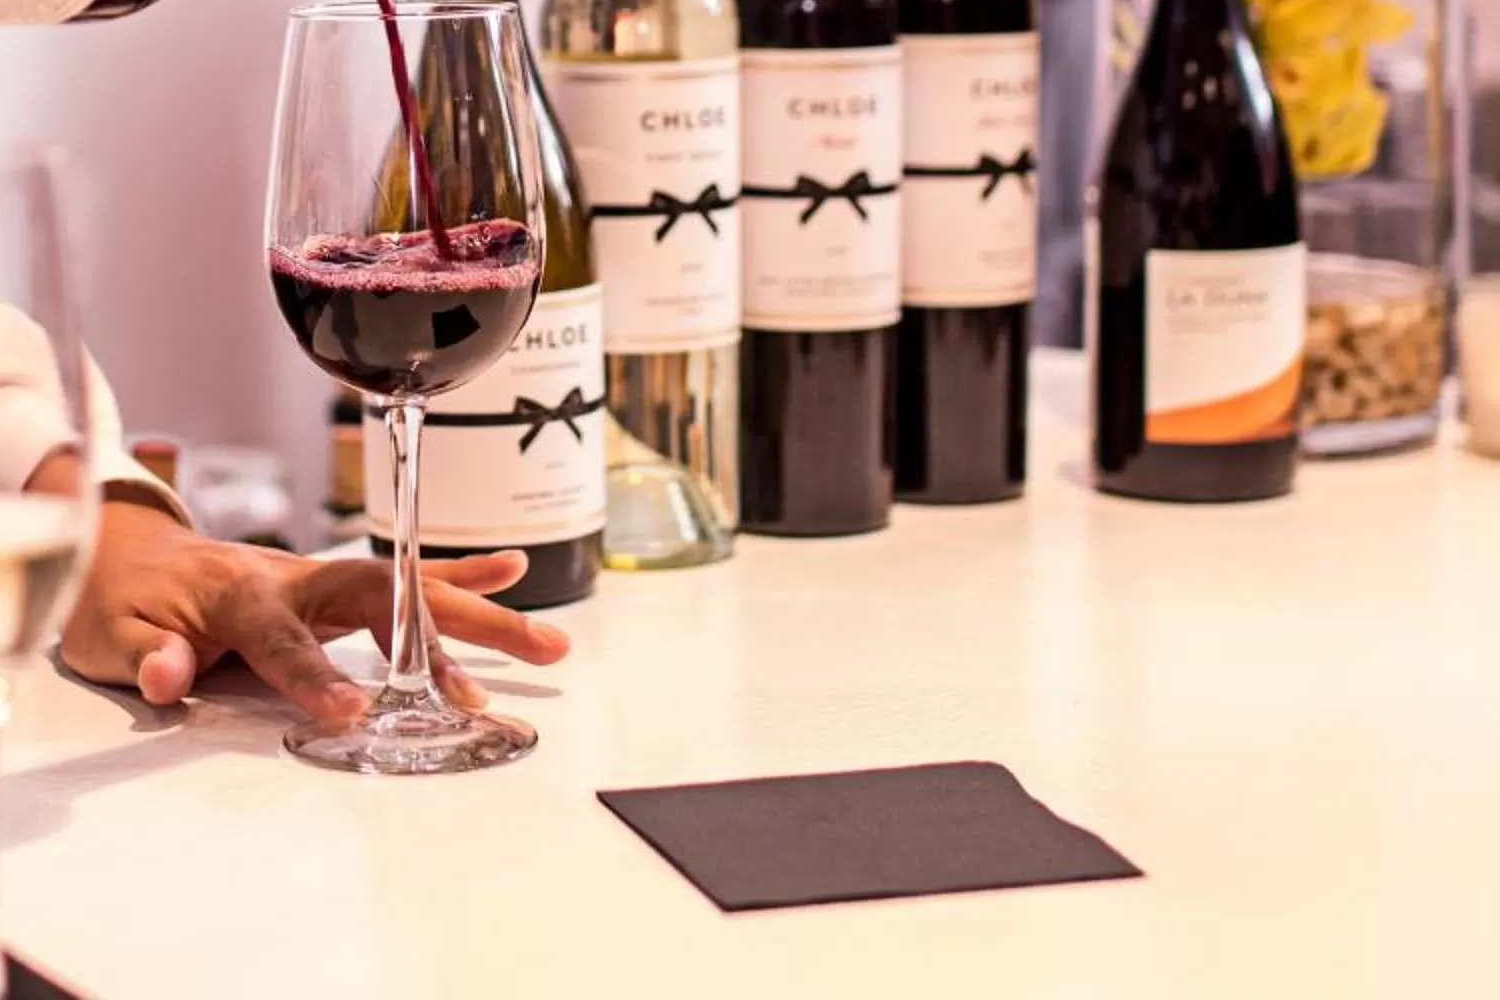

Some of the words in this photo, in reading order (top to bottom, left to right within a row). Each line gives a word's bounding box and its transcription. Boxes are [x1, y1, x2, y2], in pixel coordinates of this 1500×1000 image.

[639, 105, 725, 133] CHLOE
[785, 95, 877, 120] CHLOE
[507, 322, 590, 352] HLOE
